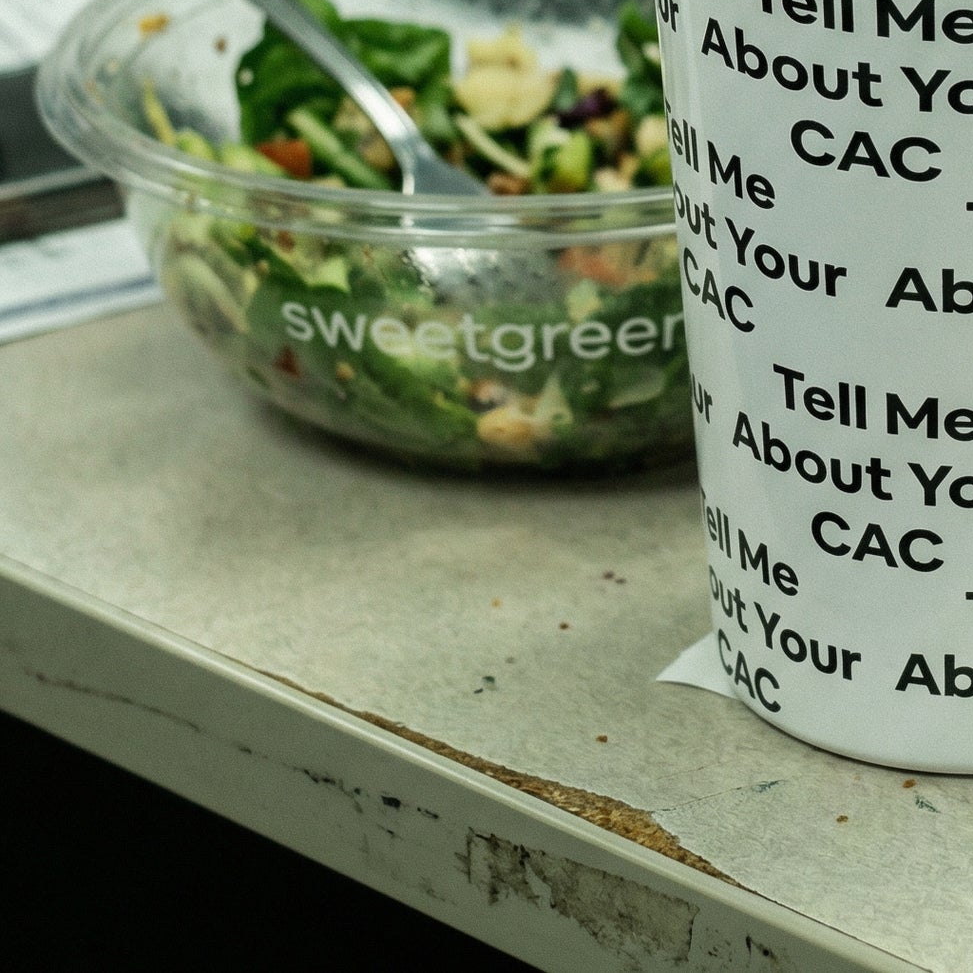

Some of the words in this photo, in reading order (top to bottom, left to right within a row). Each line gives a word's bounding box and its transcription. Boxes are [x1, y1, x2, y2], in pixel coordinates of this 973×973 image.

[700, 16, 884, 108] About
[706, 139, 776, 210] Me
[790, 119, 943, 183] CAC
[682, 246, 756, 333] CAC
[724, 216, 848, 298] Your
[772, 362, 868, 431] Tell
[732, 410, 894, 501] About
[737, 527, 799, 597] Me
[810, 511, 945, 573] CAC
[717, 628, 782, 713] CAC
[753, 600, 862, 681] Your
